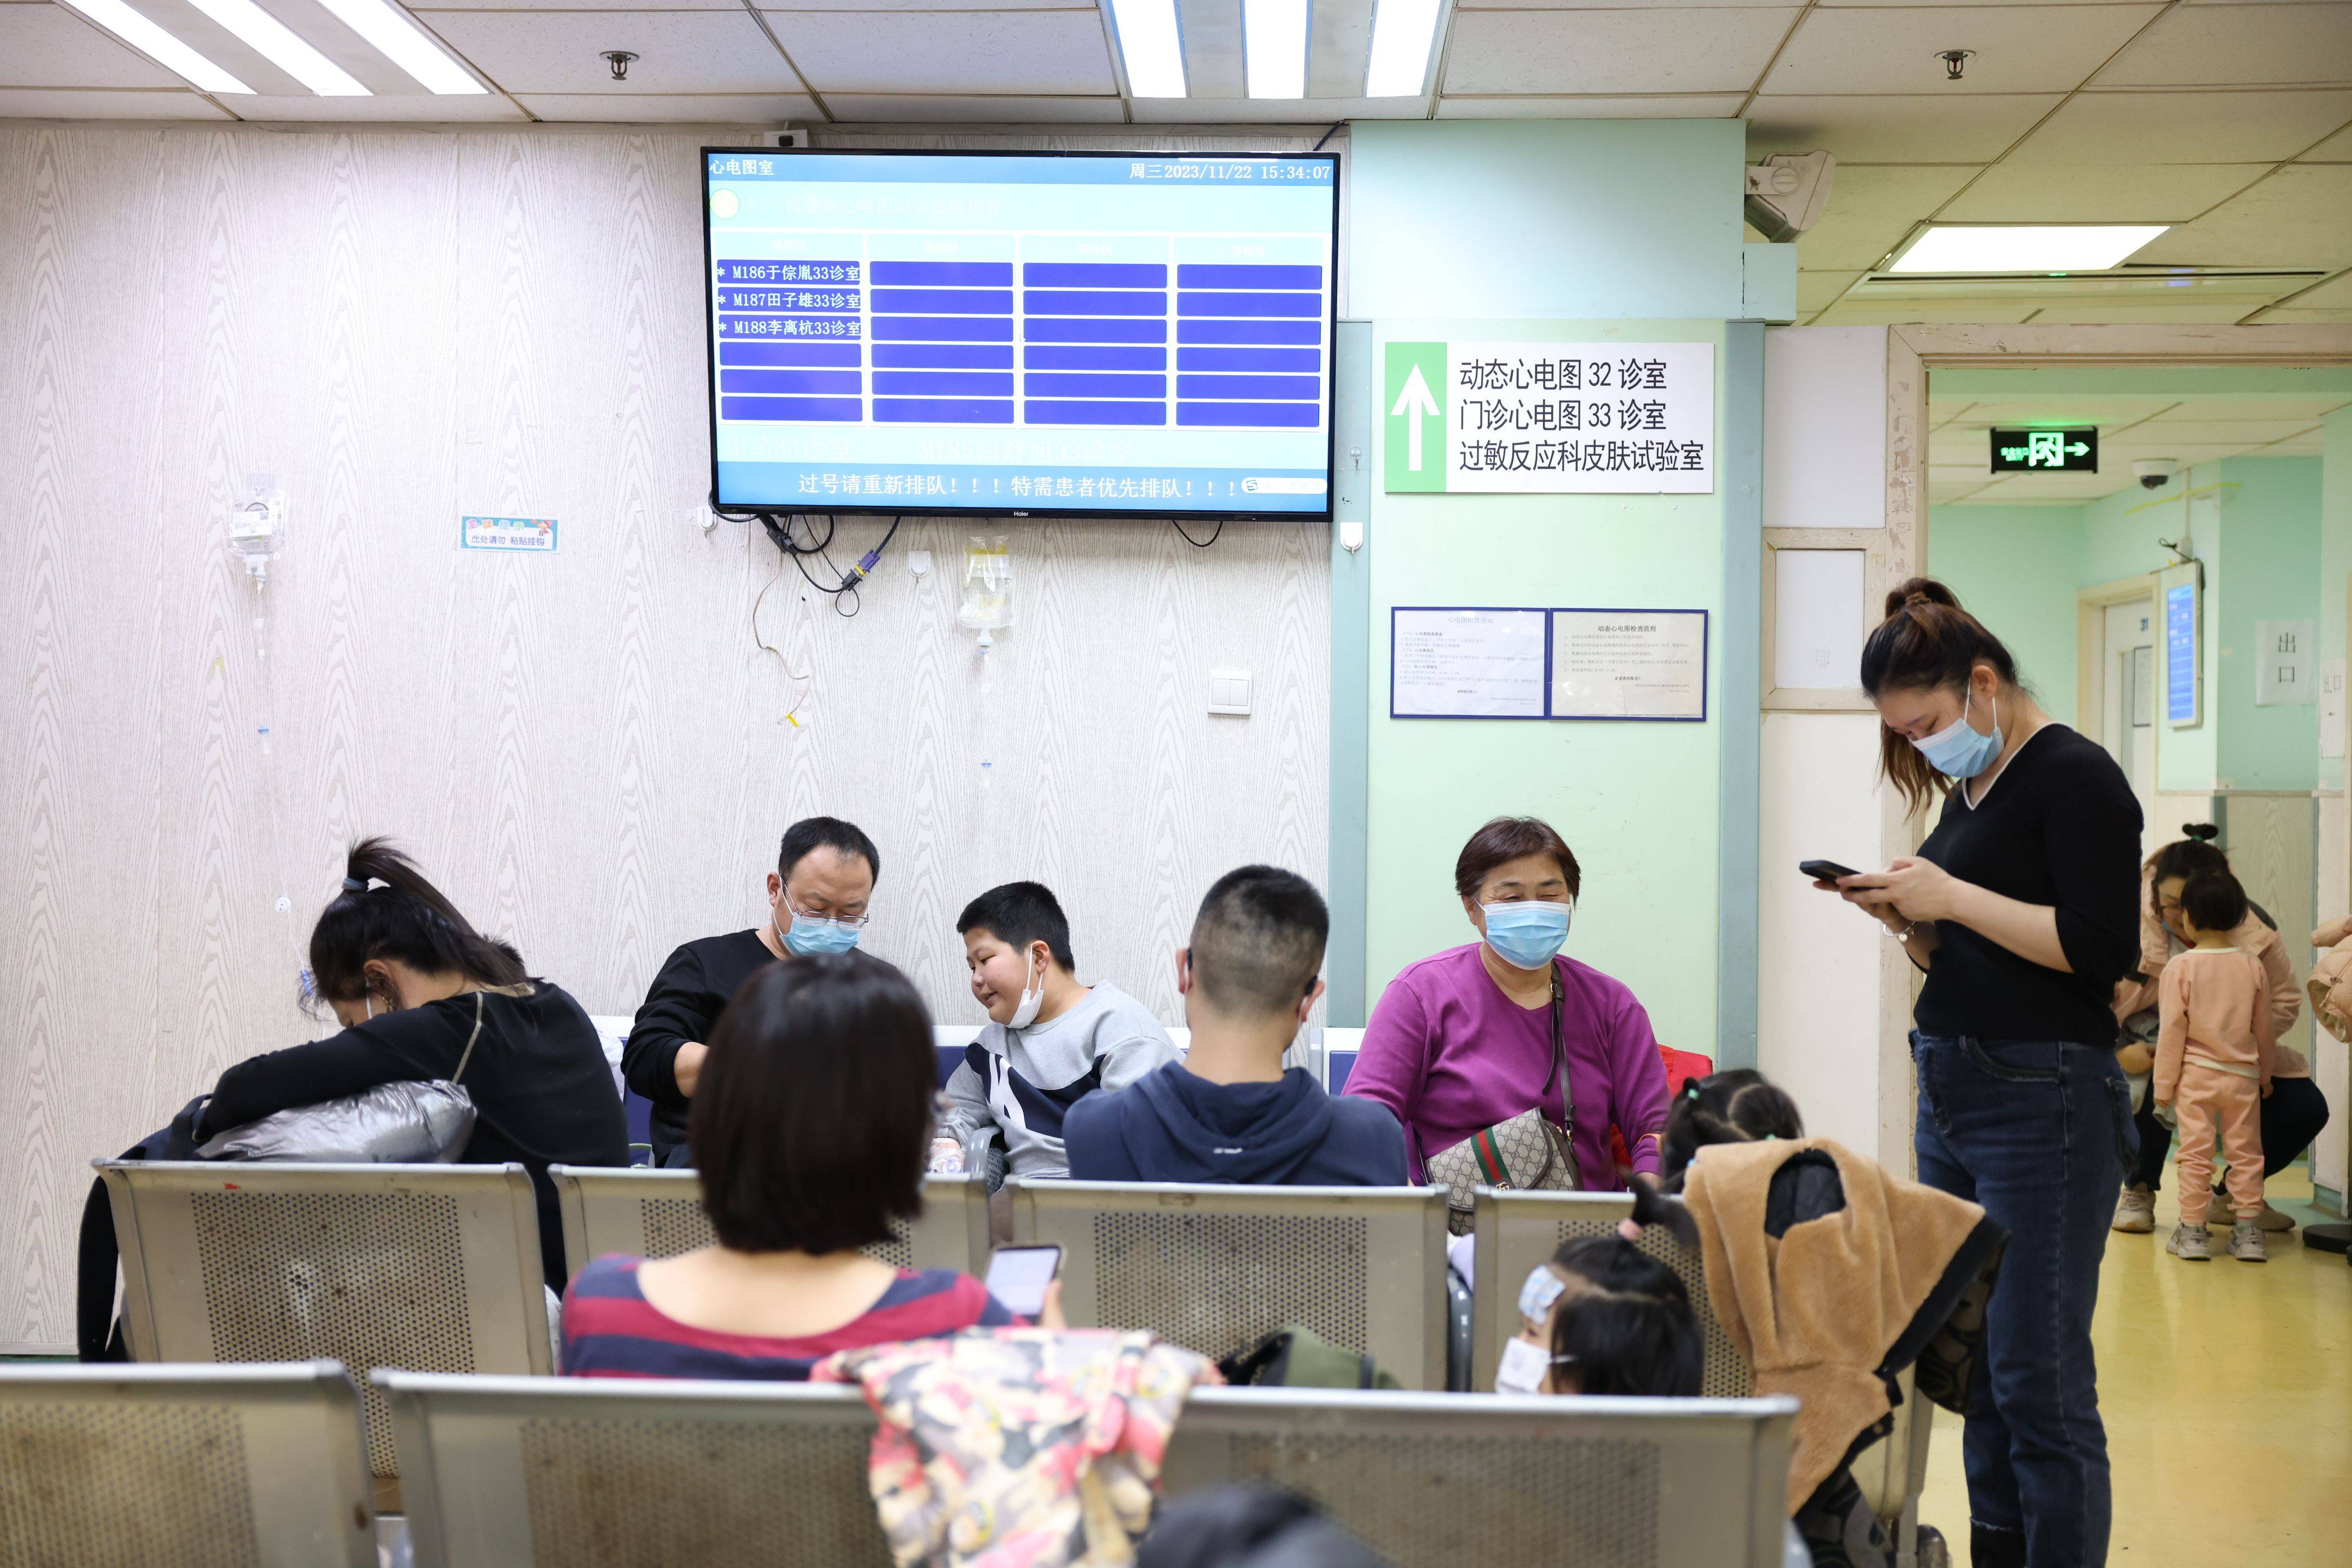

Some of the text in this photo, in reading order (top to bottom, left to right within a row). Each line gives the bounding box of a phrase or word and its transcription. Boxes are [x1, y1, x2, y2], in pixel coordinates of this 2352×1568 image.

[710, 159, 774, 176] 心电图室
[1261, 165, 1330, 179] 15:34:07
[1460, 358, 1667, 390] 动态心电图 32 诊室
[1460, 399, 1667, 430] 门诊心电图 33 诊室
[1459, 439, 1704, 472] 过敏反应科皮肤试验室
[2278, 632, 2296, 683] 出口
